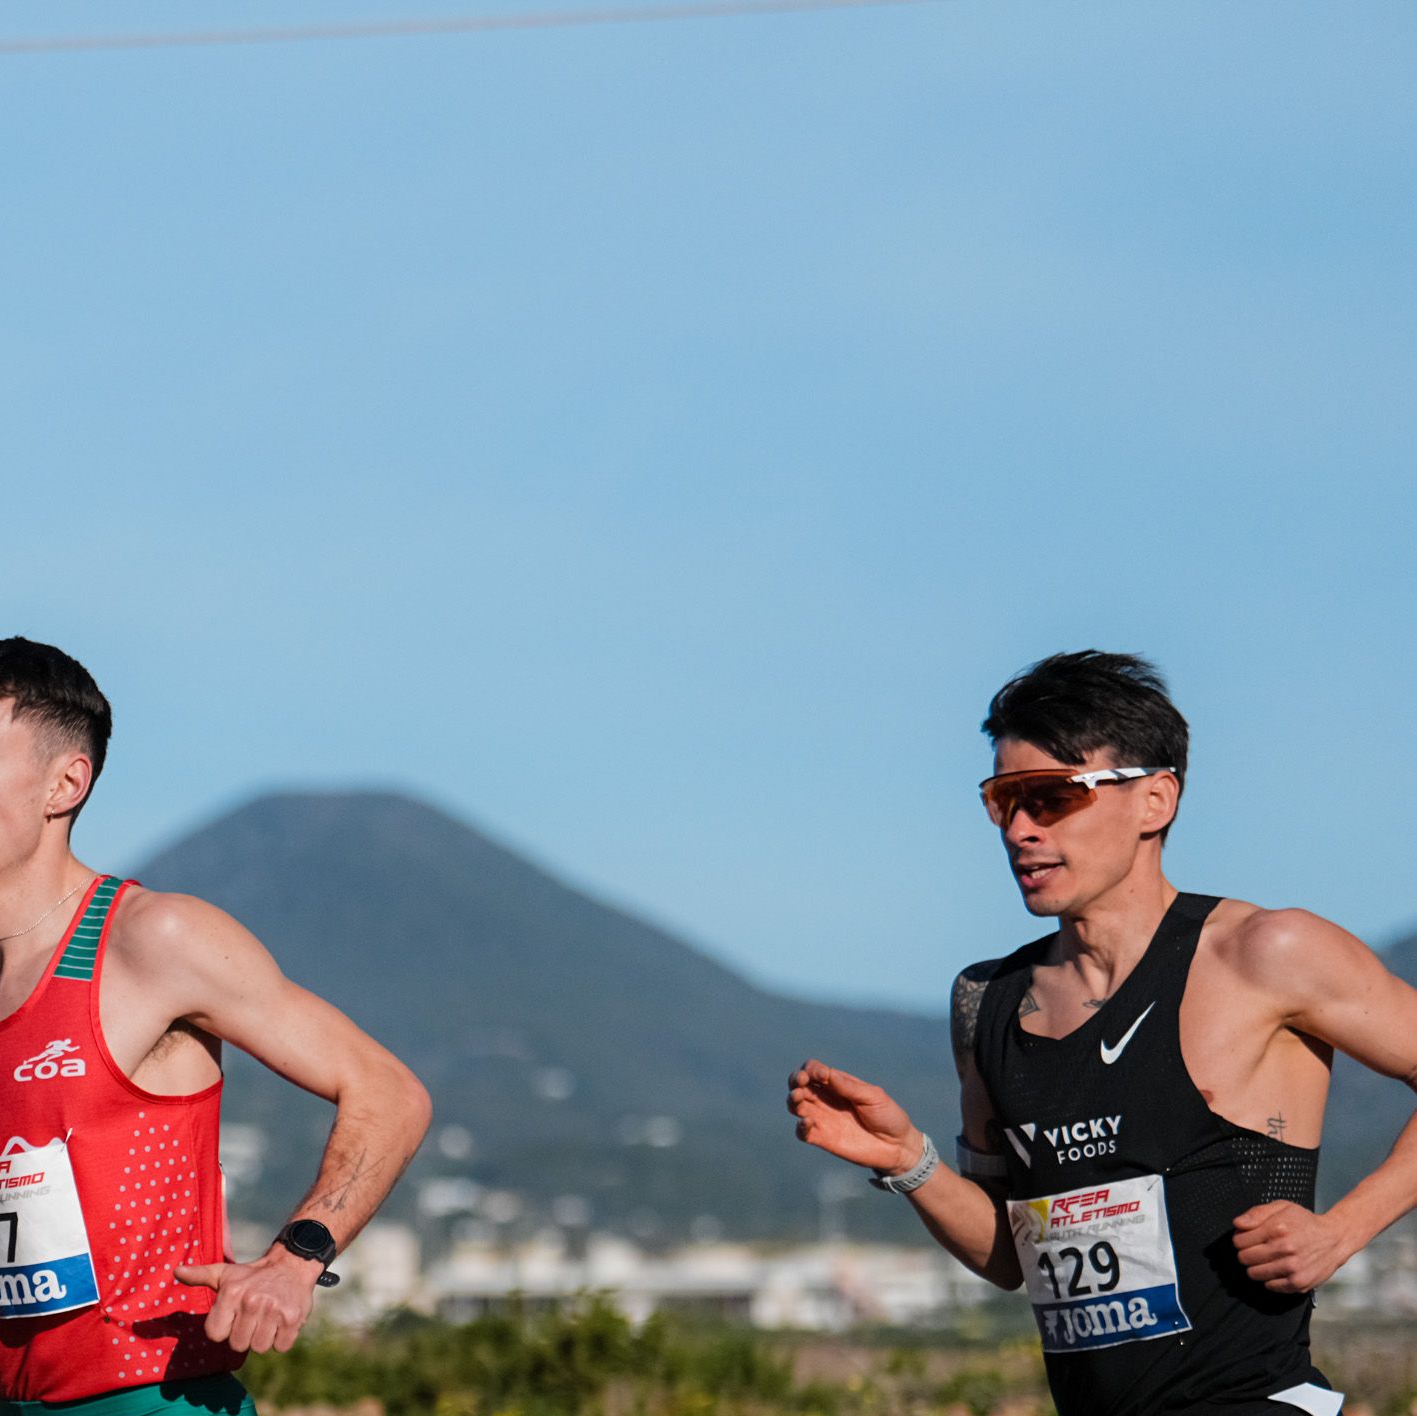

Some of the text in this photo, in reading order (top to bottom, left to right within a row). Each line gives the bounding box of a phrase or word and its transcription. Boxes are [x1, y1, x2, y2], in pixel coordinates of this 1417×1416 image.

[1043, 1115, 1122, 1148] VICKY
[1057, 1140, 1116, 1165] FOODS
[1051, 1189, 1110, 1214] RFEA
[1050, 1201, 1141, 1229] ATLETISMO
[1086, 1214, 1146, 1236] RUNNING
[1037, 1240, 1120, 1299] 129
